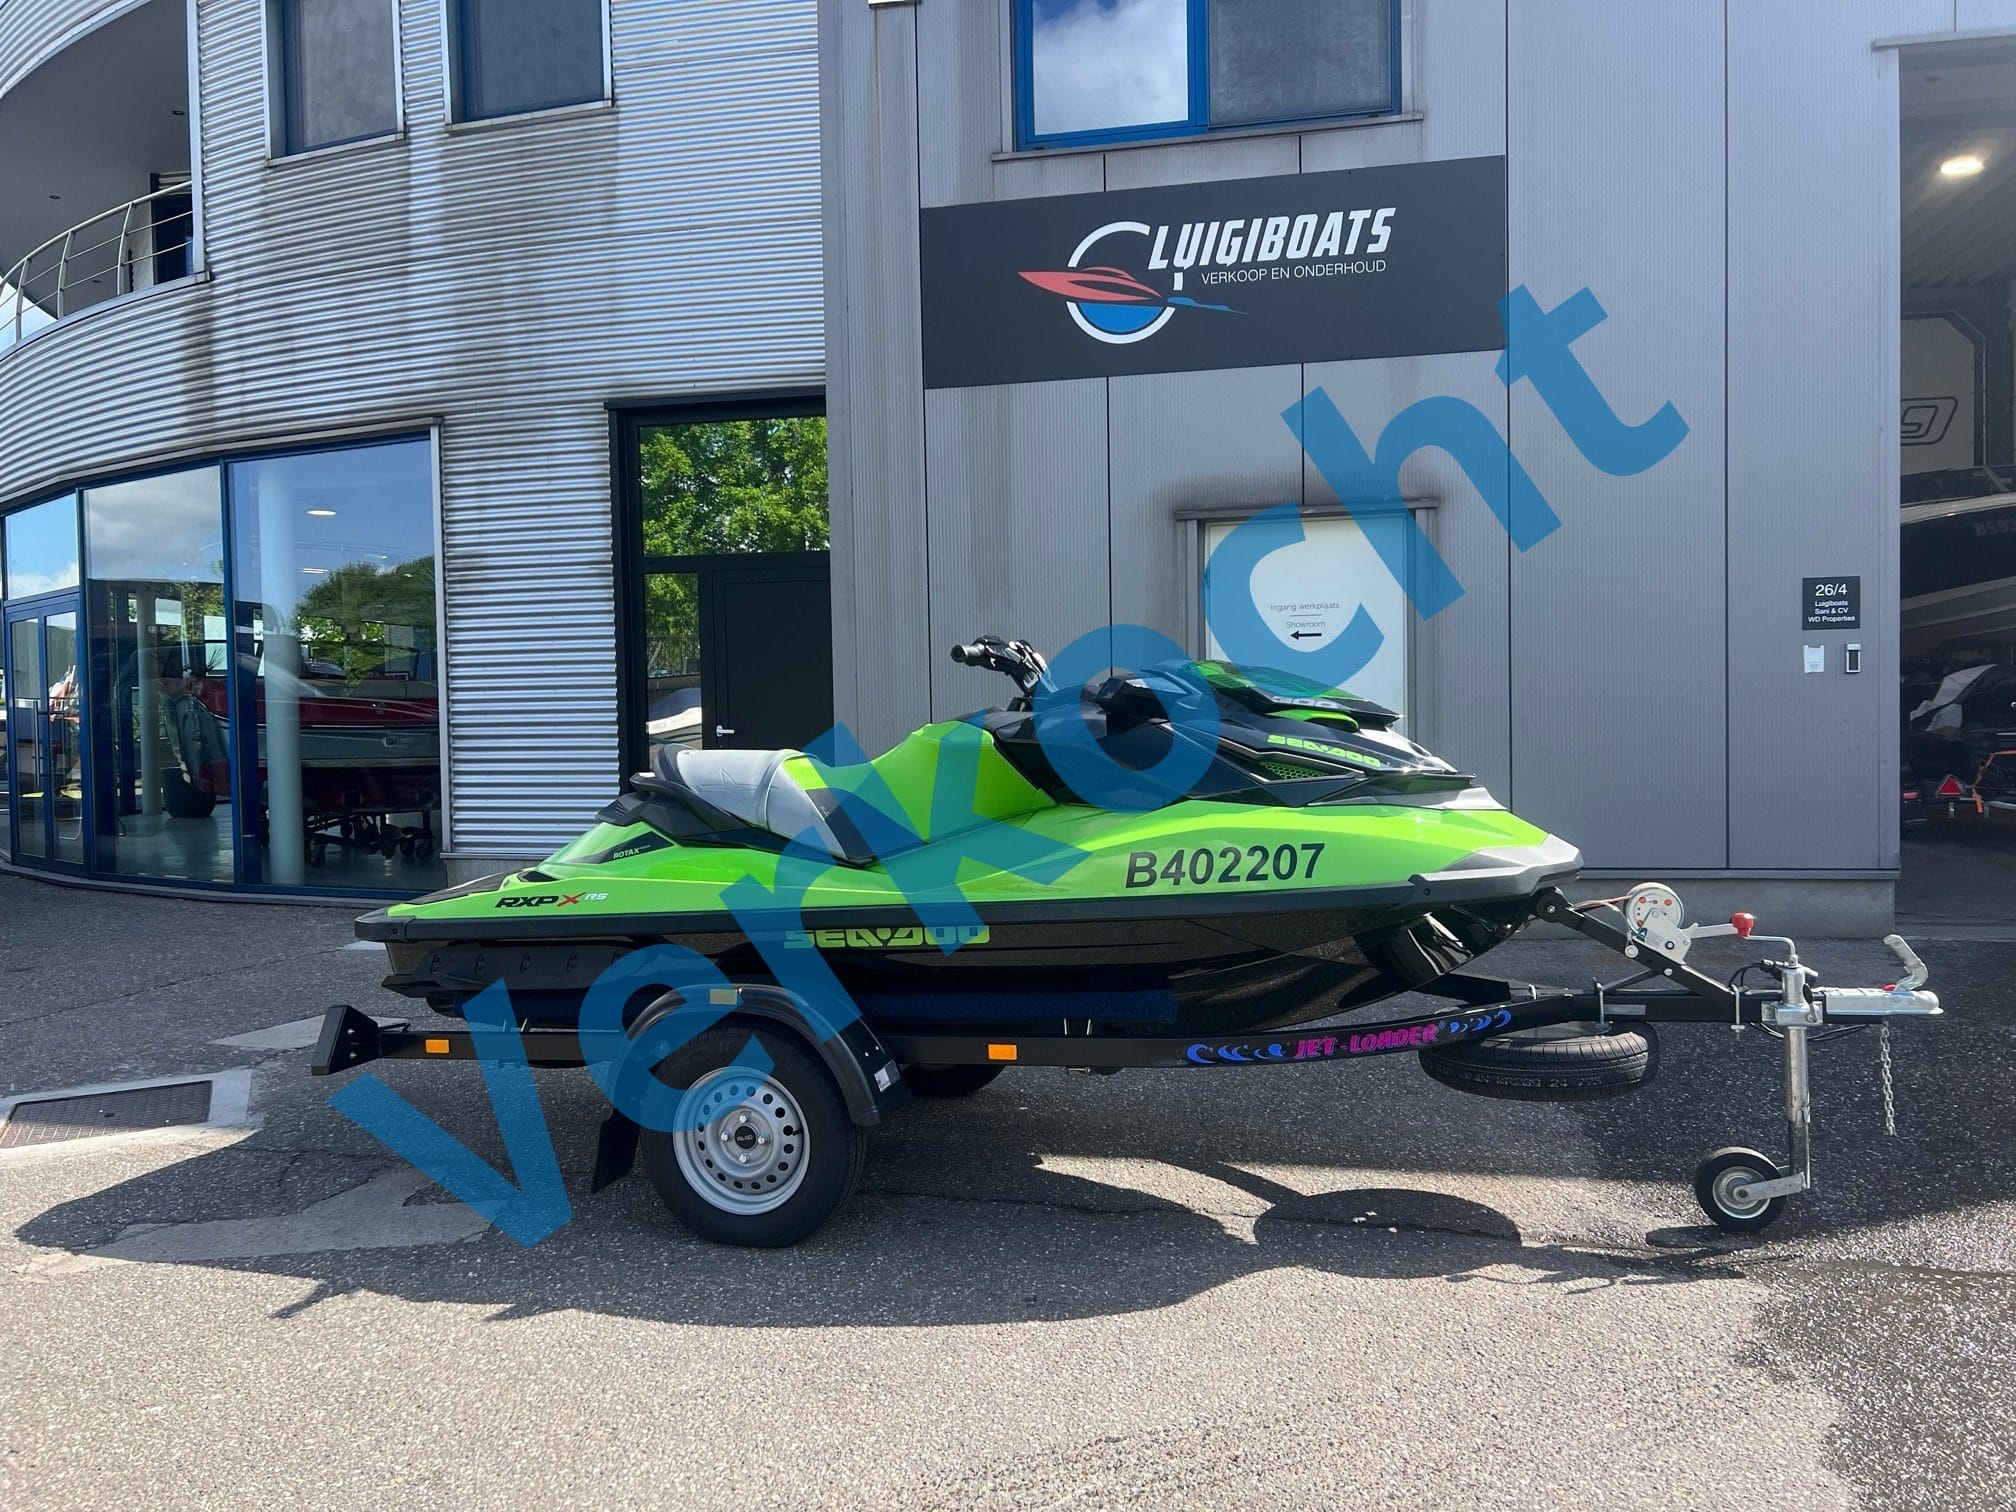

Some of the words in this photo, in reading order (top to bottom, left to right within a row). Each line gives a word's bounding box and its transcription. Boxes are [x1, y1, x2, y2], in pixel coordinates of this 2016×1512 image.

[1148, 207, 1396, 270] LUIGIBOATS
[1201, 268, 1267, 285] VERKOOP
[1272, 266, 1290, 280] EN
[1295, 259, 1386, 278] ONDERHOUD
[1815, 583, 1848, 597] 26/4
[1270, 603, 1297, 612] Ingang
[1298, 602, 1340, 610] werkplaats
[1286, 621, 1326, 629] Showroom
[613, 847, 640, 860] ROTAX
[1125, 843, 1325, 889] B402207
